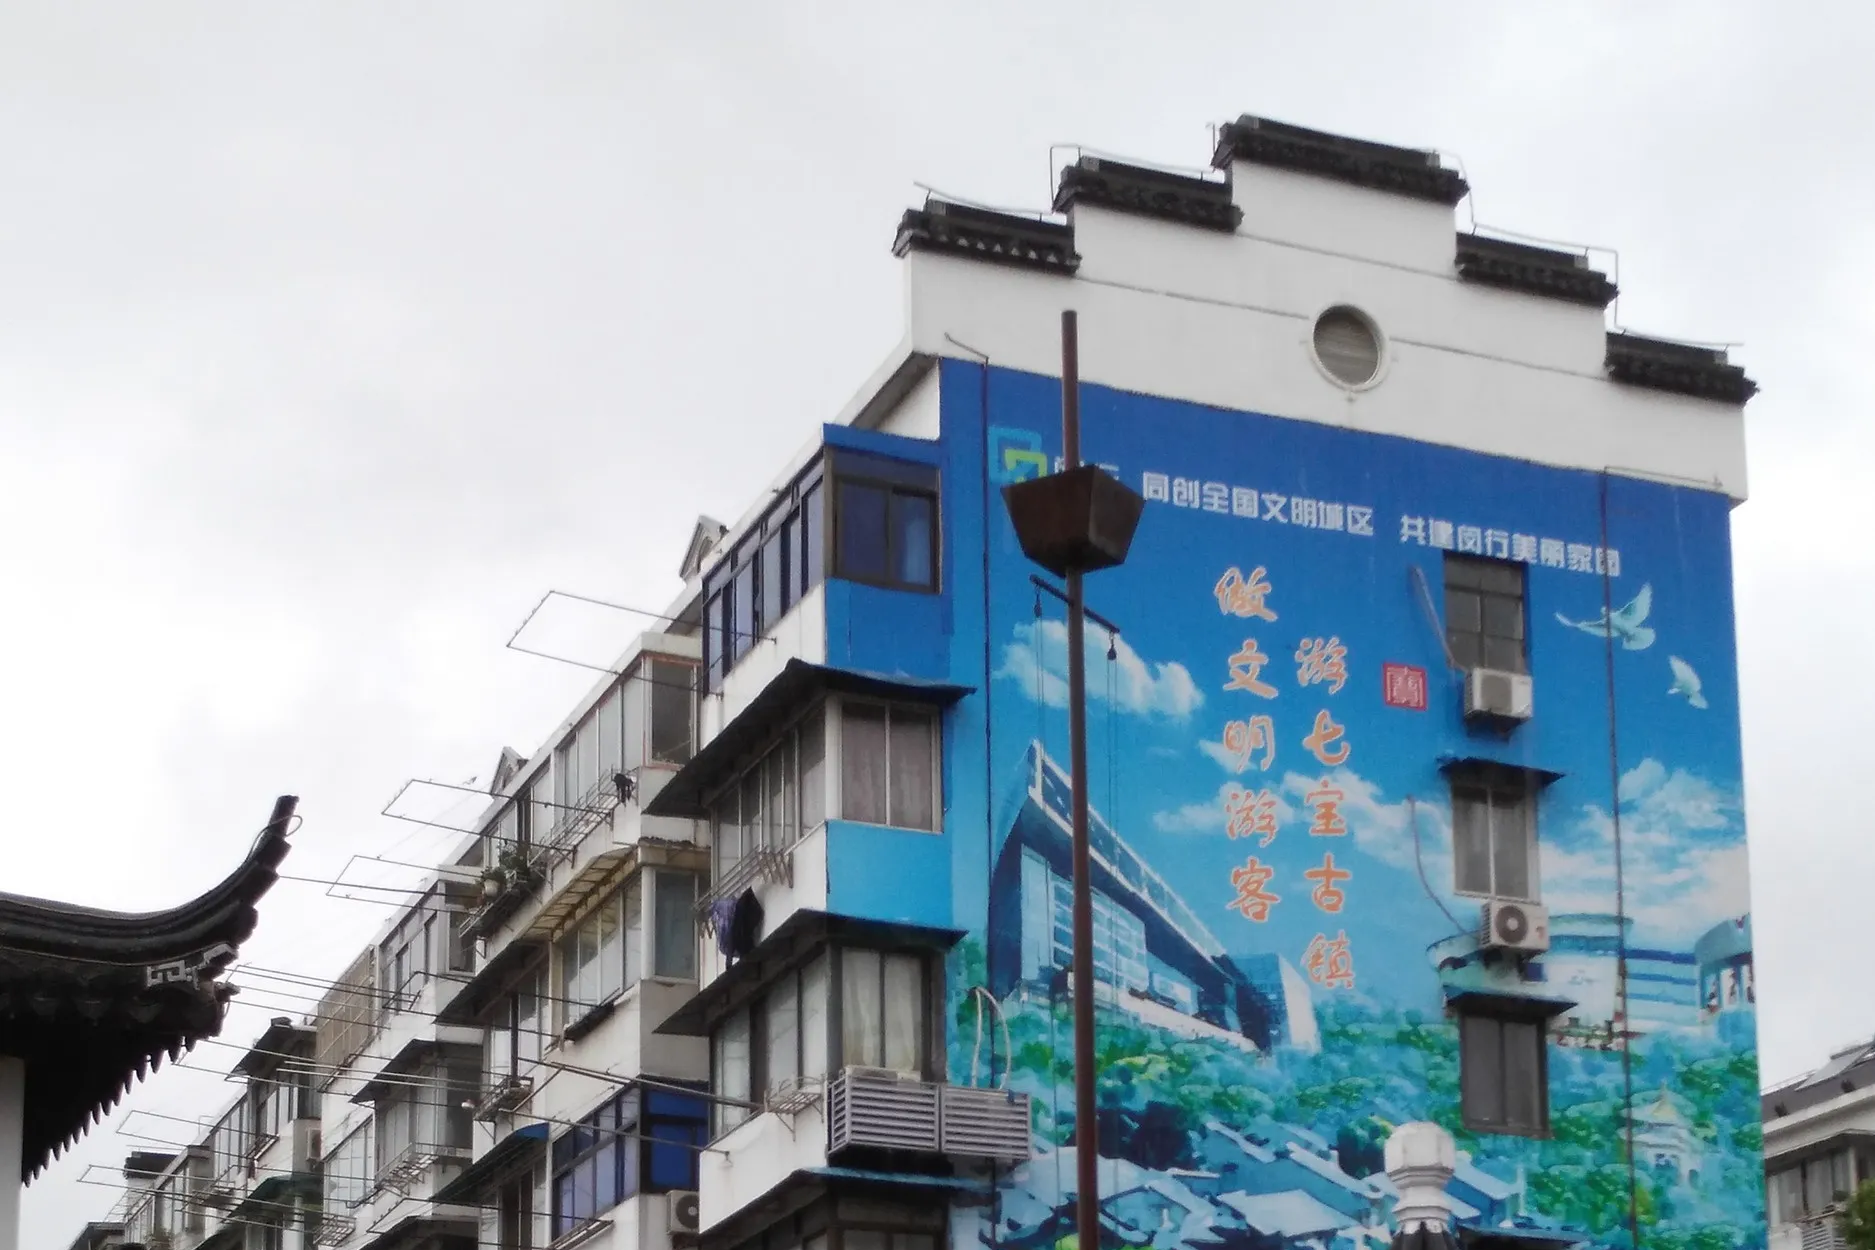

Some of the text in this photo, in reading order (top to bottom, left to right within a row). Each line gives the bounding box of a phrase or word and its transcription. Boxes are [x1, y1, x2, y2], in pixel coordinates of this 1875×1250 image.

[1142, 470, 1621, 577] 同创全国文明城区 共建闵行美丽家园
[1214, 566, 1281, 923] 做文明游客
